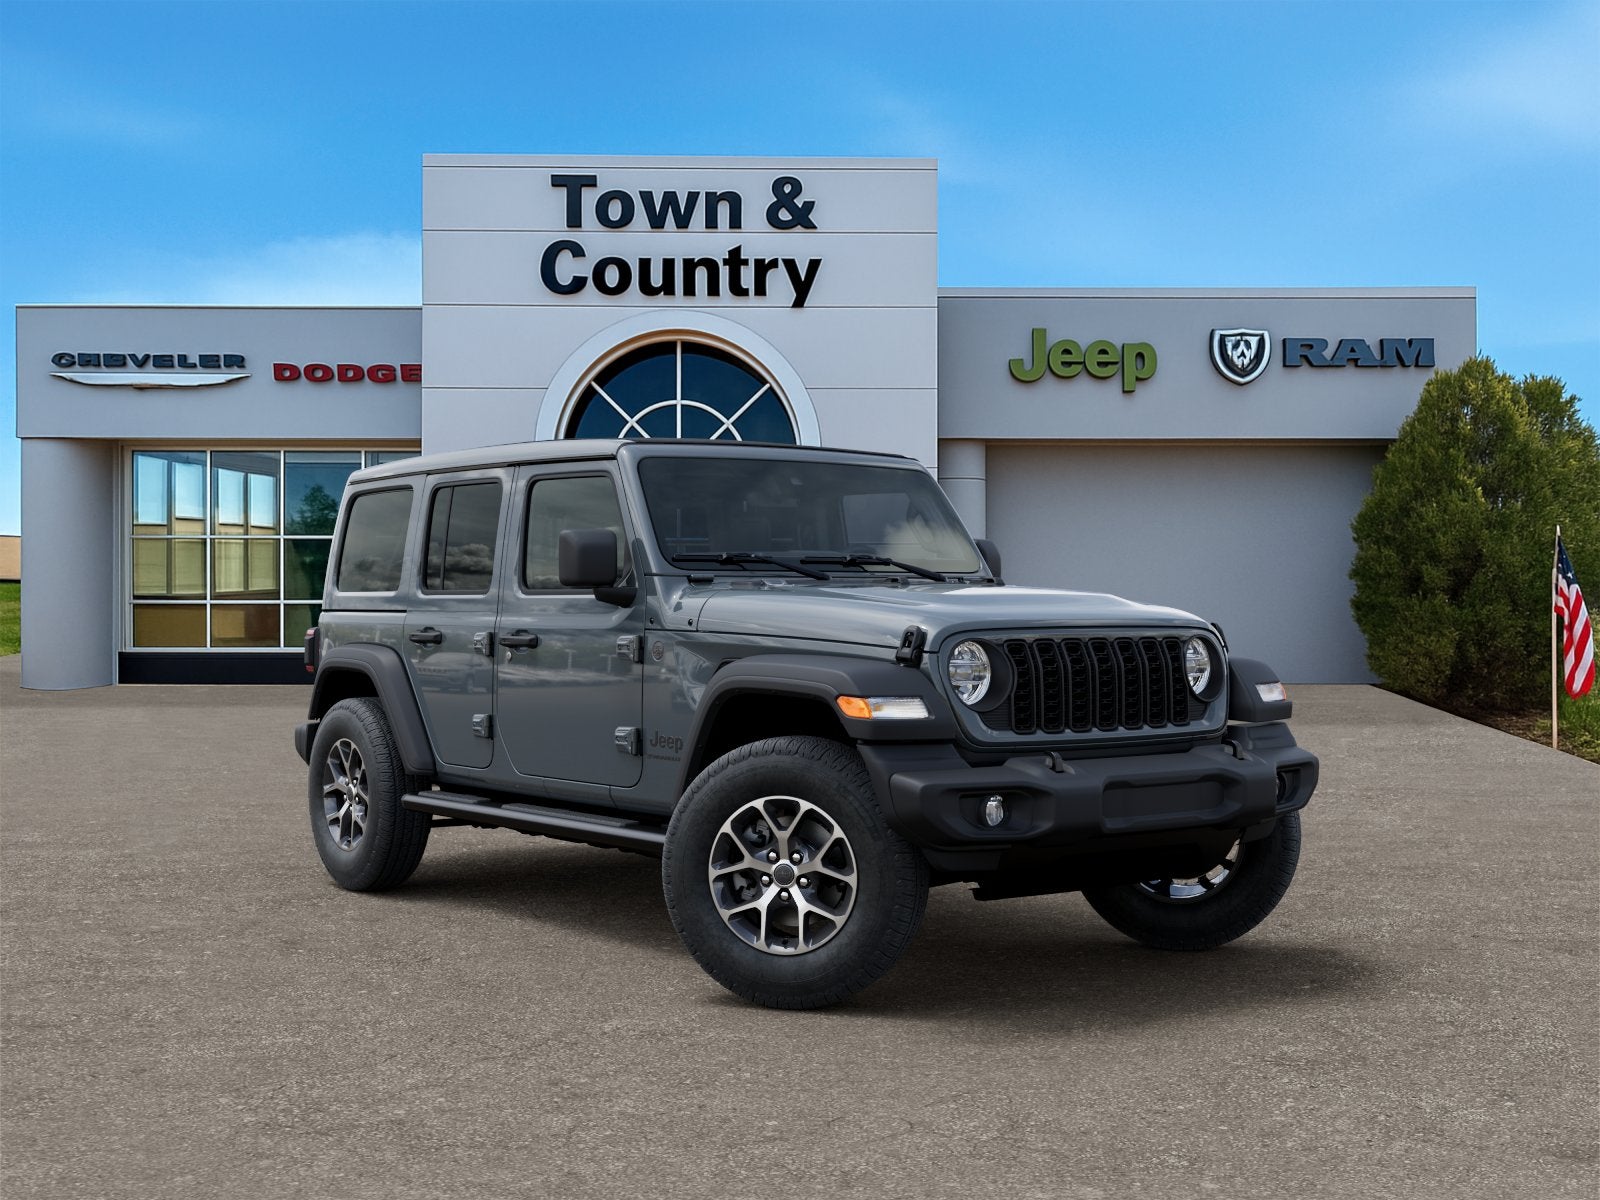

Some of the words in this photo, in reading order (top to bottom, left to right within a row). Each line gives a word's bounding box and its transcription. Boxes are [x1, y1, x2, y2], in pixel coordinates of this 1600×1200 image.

[550, 174, 743, 230] Town
[765, 175, 818, 230] &
[539, 239, 823, 308] Country
[273, 363, 422, 383] DODGE
[1009, 328, 1158, 393] Jeep
[1282, 337, 1436, 368] RAM
[650, 729, 683, 754] Jeep
